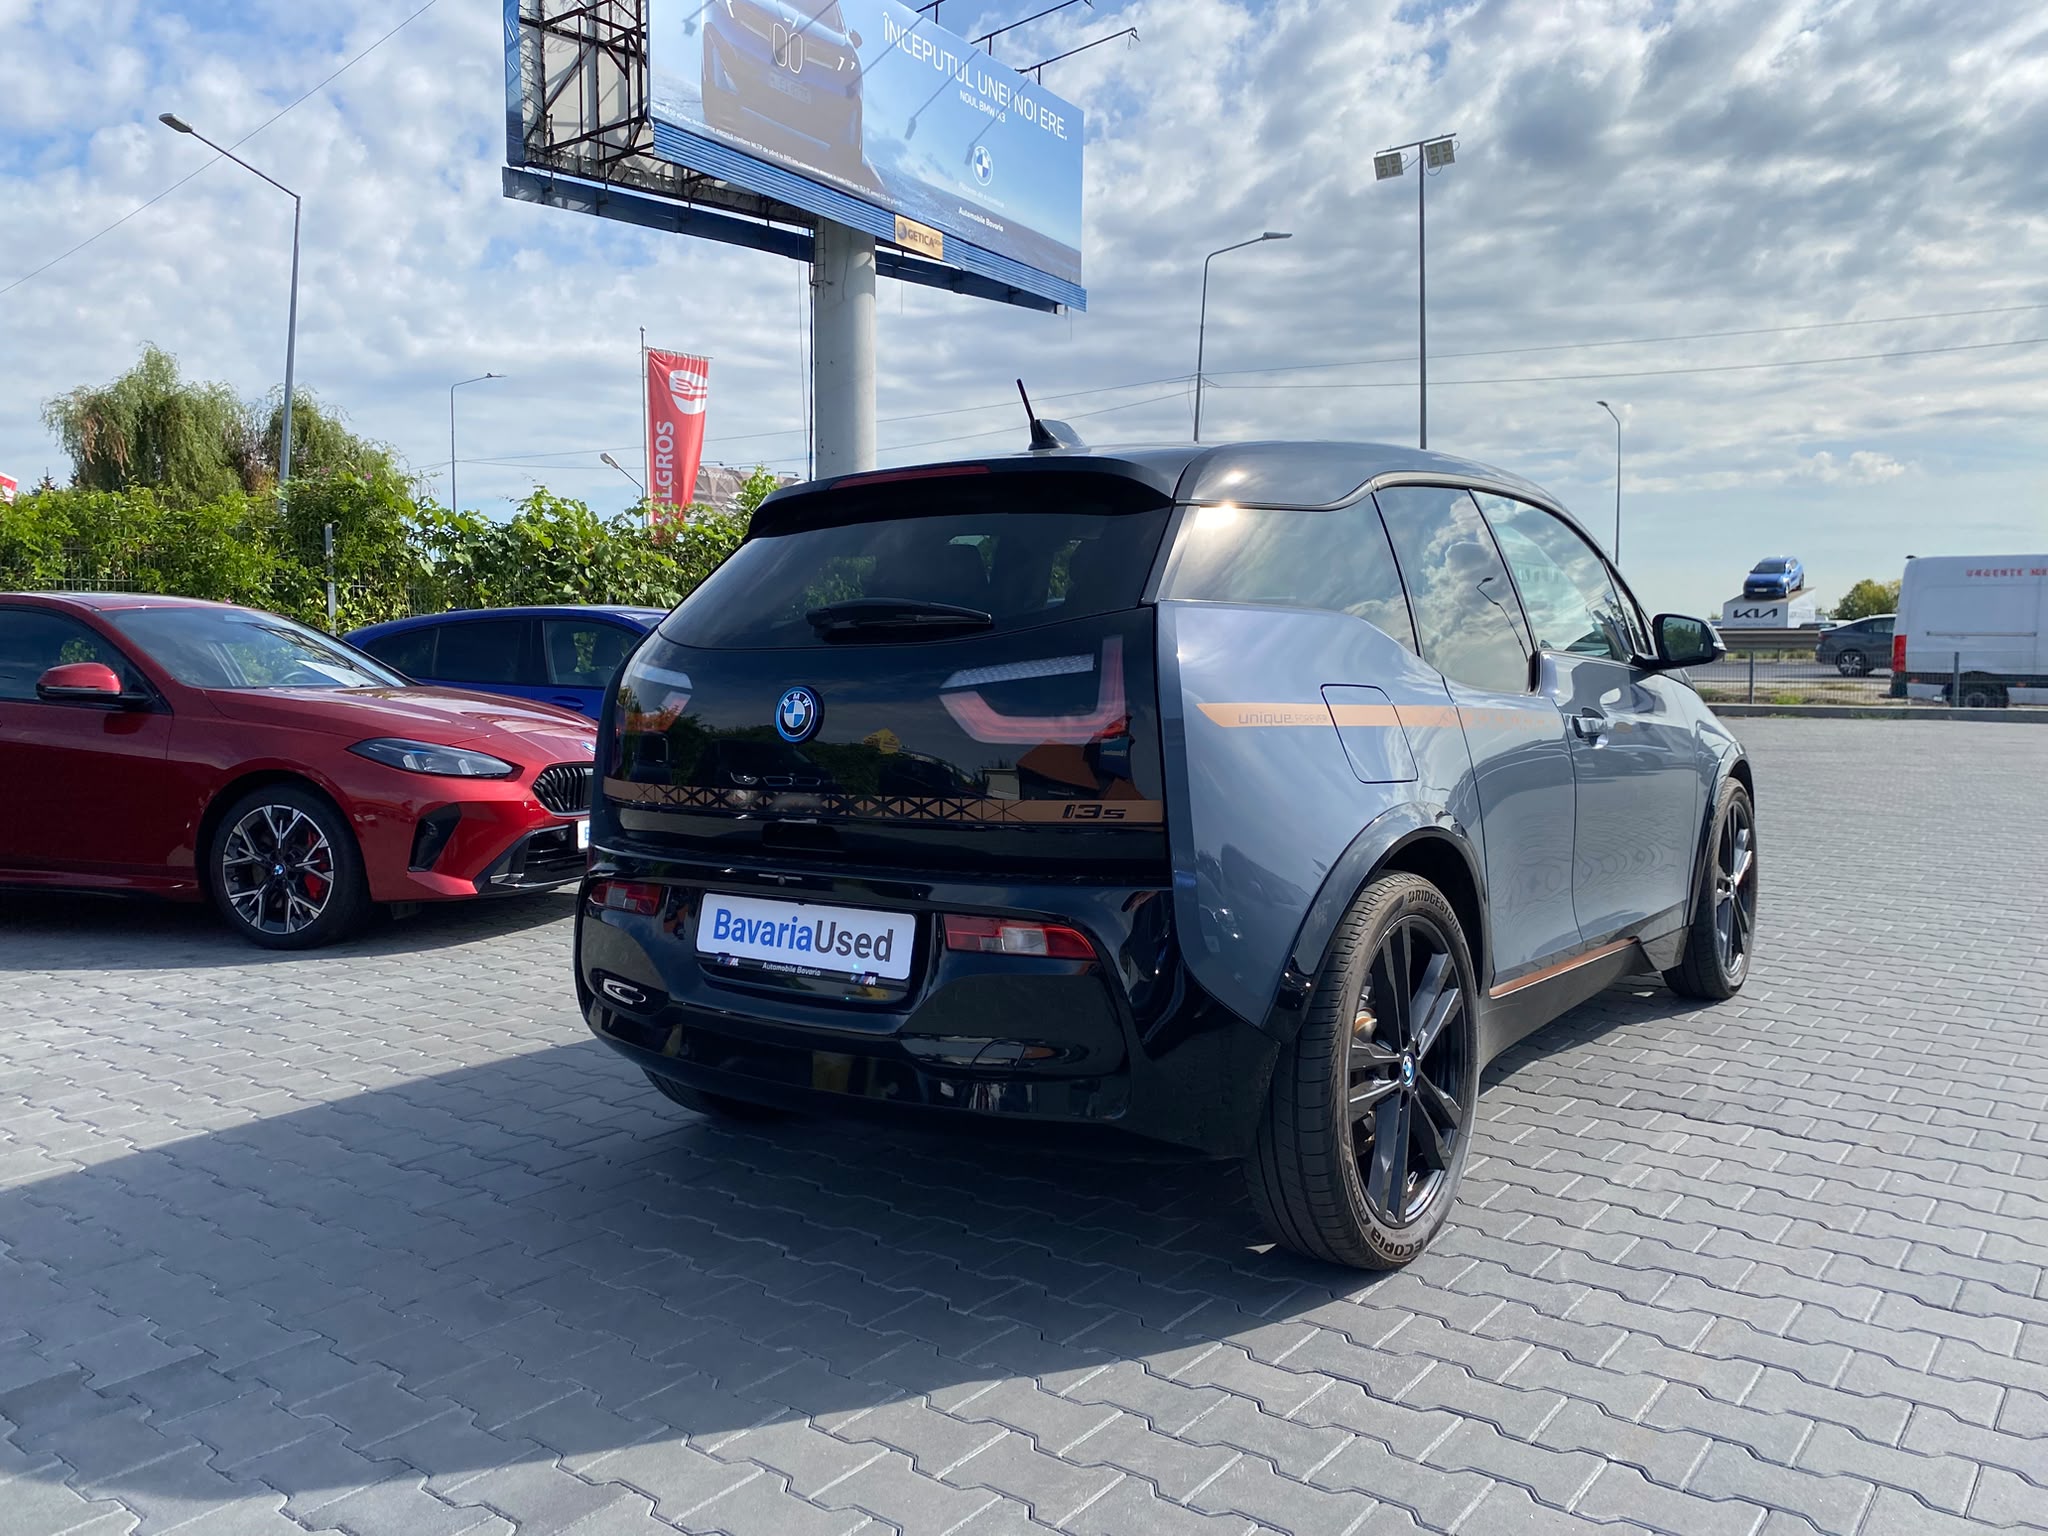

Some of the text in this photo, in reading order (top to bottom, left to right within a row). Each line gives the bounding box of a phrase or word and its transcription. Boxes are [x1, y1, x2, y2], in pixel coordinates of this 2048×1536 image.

[883, 12, 1068, 140] ÎNCEPUTUL UNEI NOI ERE.
[960, 90, 978, 108] NOUL
[979, 100, 995, 117] BMW
[959, 206, 1003, 232] Automobile Bavaria
[908, 229, 934, 248] GETICA
[1733, 608, 1778, 619] KIA
[1062, 804, 1126, 819] i3s
[713, 908, 894, 962] BavariaUsed
[762, 961, 822, 976] Automobile Bavaria
